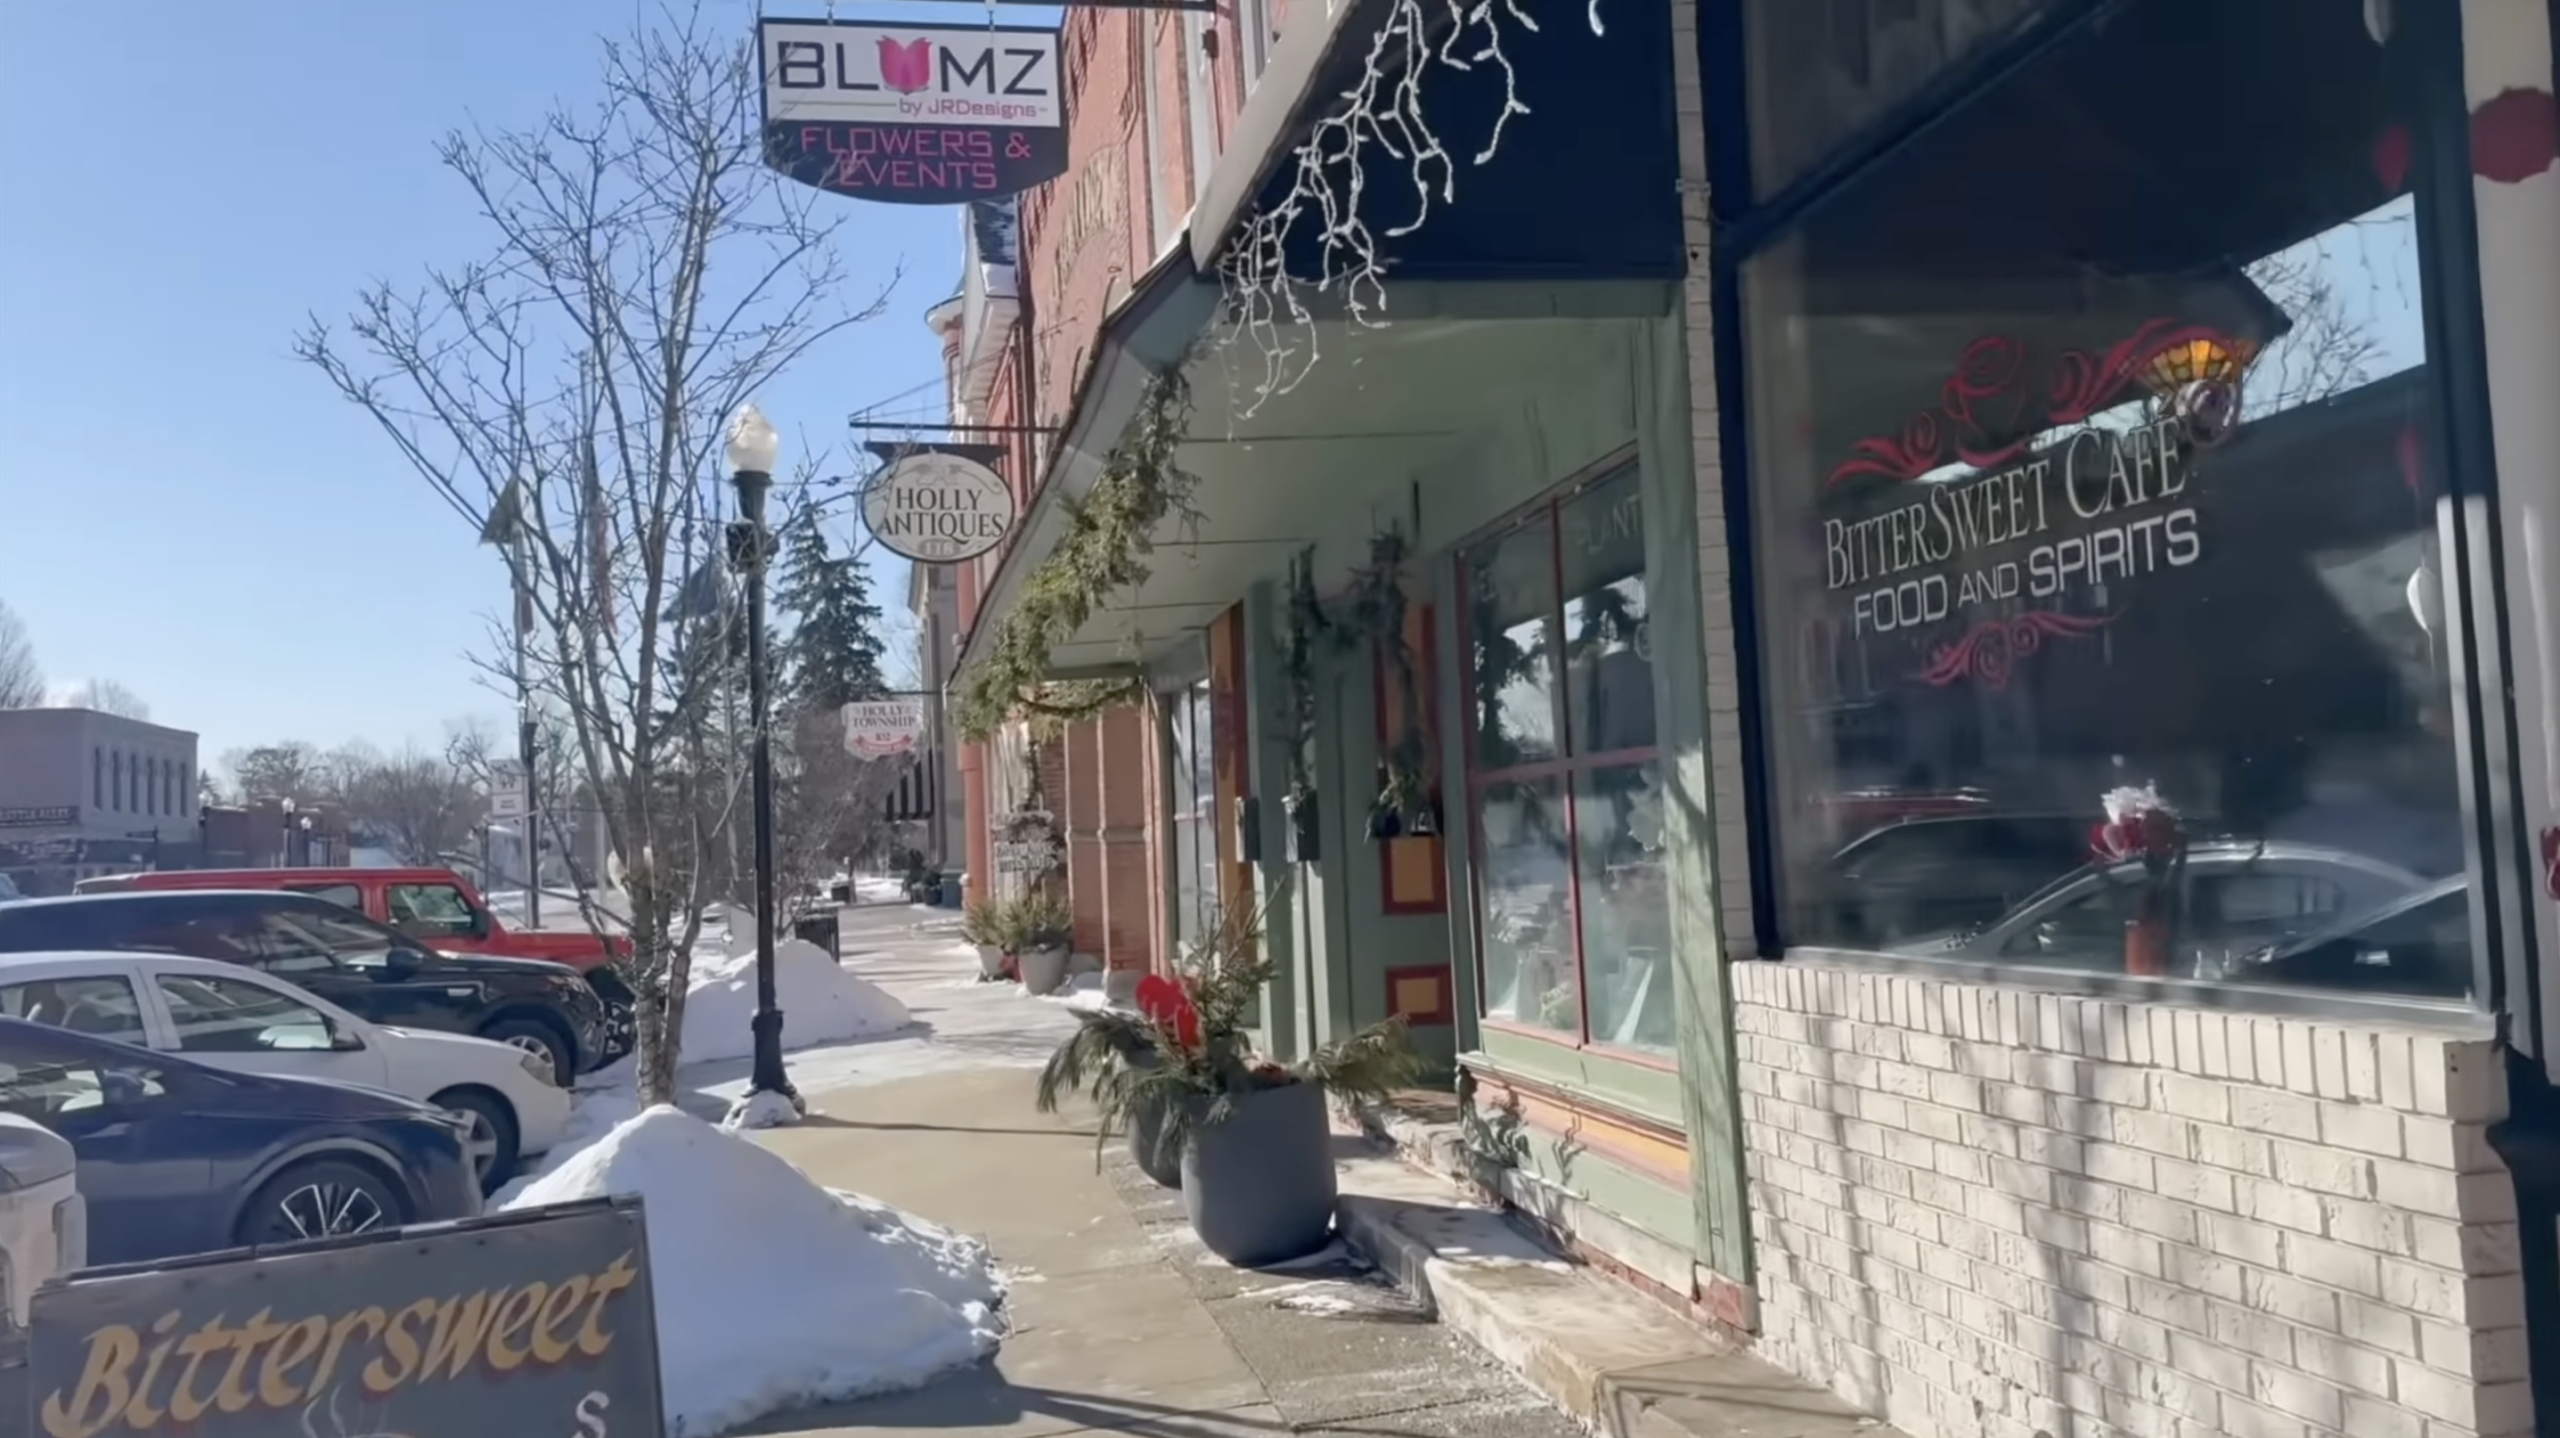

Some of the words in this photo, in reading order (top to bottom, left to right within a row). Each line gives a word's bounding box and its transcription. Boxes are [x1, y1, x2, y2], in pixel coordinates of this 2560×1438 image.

[899, 98, 922, 117] by
[928, 100, 1037, 119] JRDesigns
[801, 127, 992, 158] FLOWERS
[1005, 132, 1031, 158] &
[840, 159, 997, 189] EVENTS
[895, 487, 984, 511] HOLLY
[881, 513, 1005, 546] ANTIQUES
[1854, 574, 1949, 640] FOOD
[1957, 561, 2020, 608] AND
[2028, 508, 2200, 597] SPIRITS
[853, 716, 917, 728] TOWNSHIP
[862, 705, 903, 717] HOLLY
[40, 1248, 638, 1438] Bittersweet
